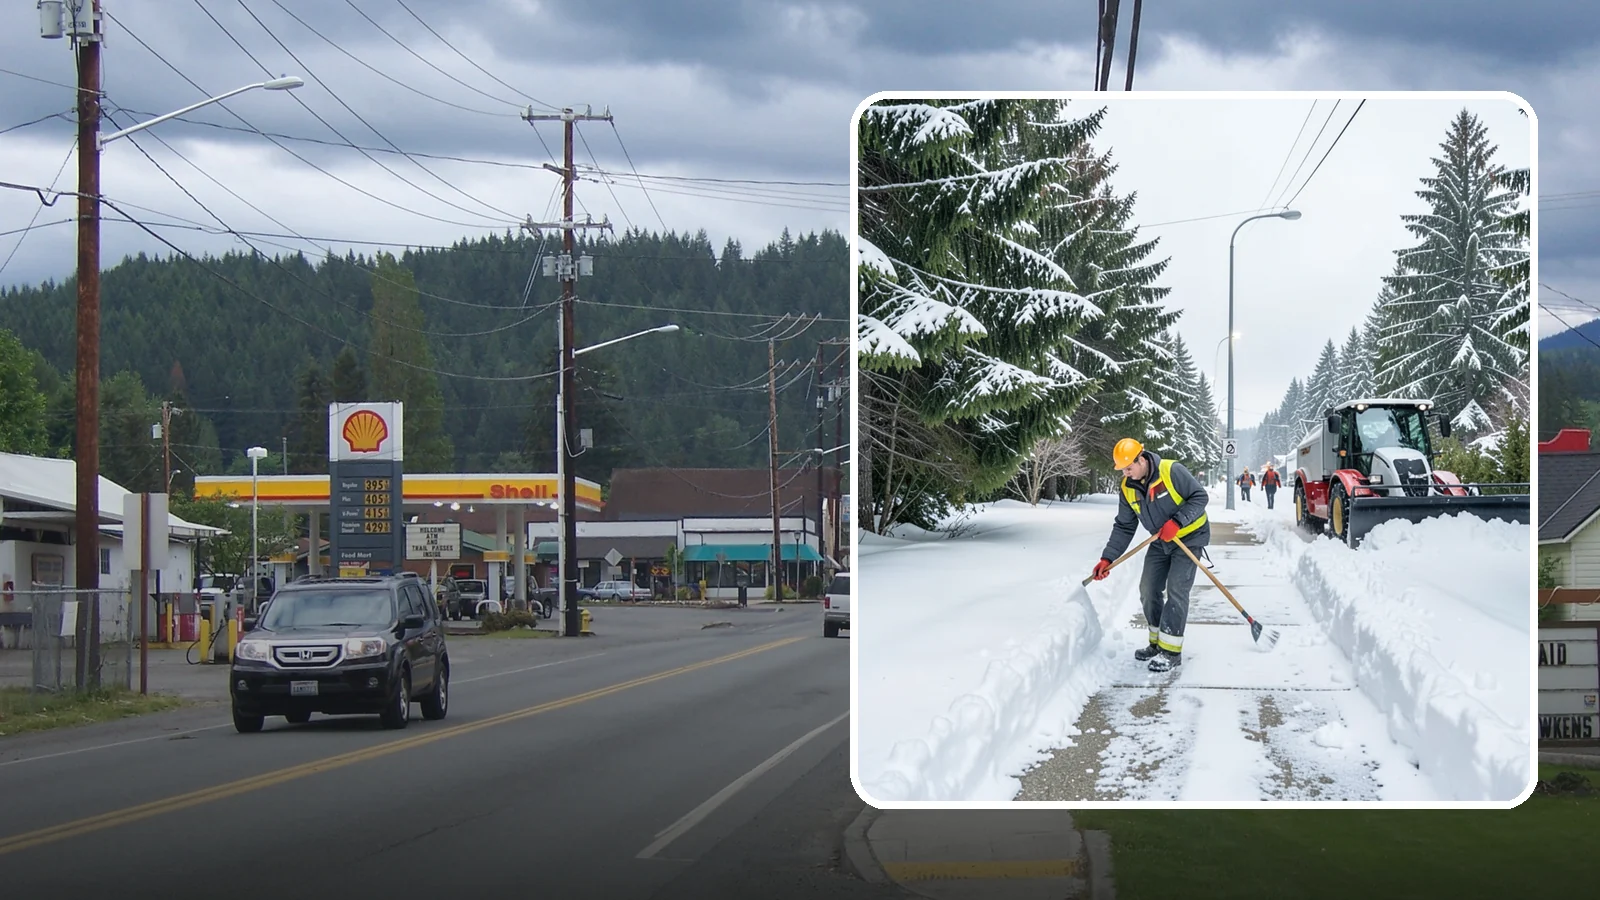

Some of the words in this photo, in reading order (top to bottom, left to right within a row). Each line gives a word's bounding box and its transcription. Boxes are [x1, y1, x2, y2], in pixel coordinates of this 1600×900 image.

[365, 480, 383, 490] 395
[490, 484, 547, 499] Shell
[365, 494, 383, 504] 405
[365, 508, 383, 518] 415
[365, 522, 383, 532] 429
